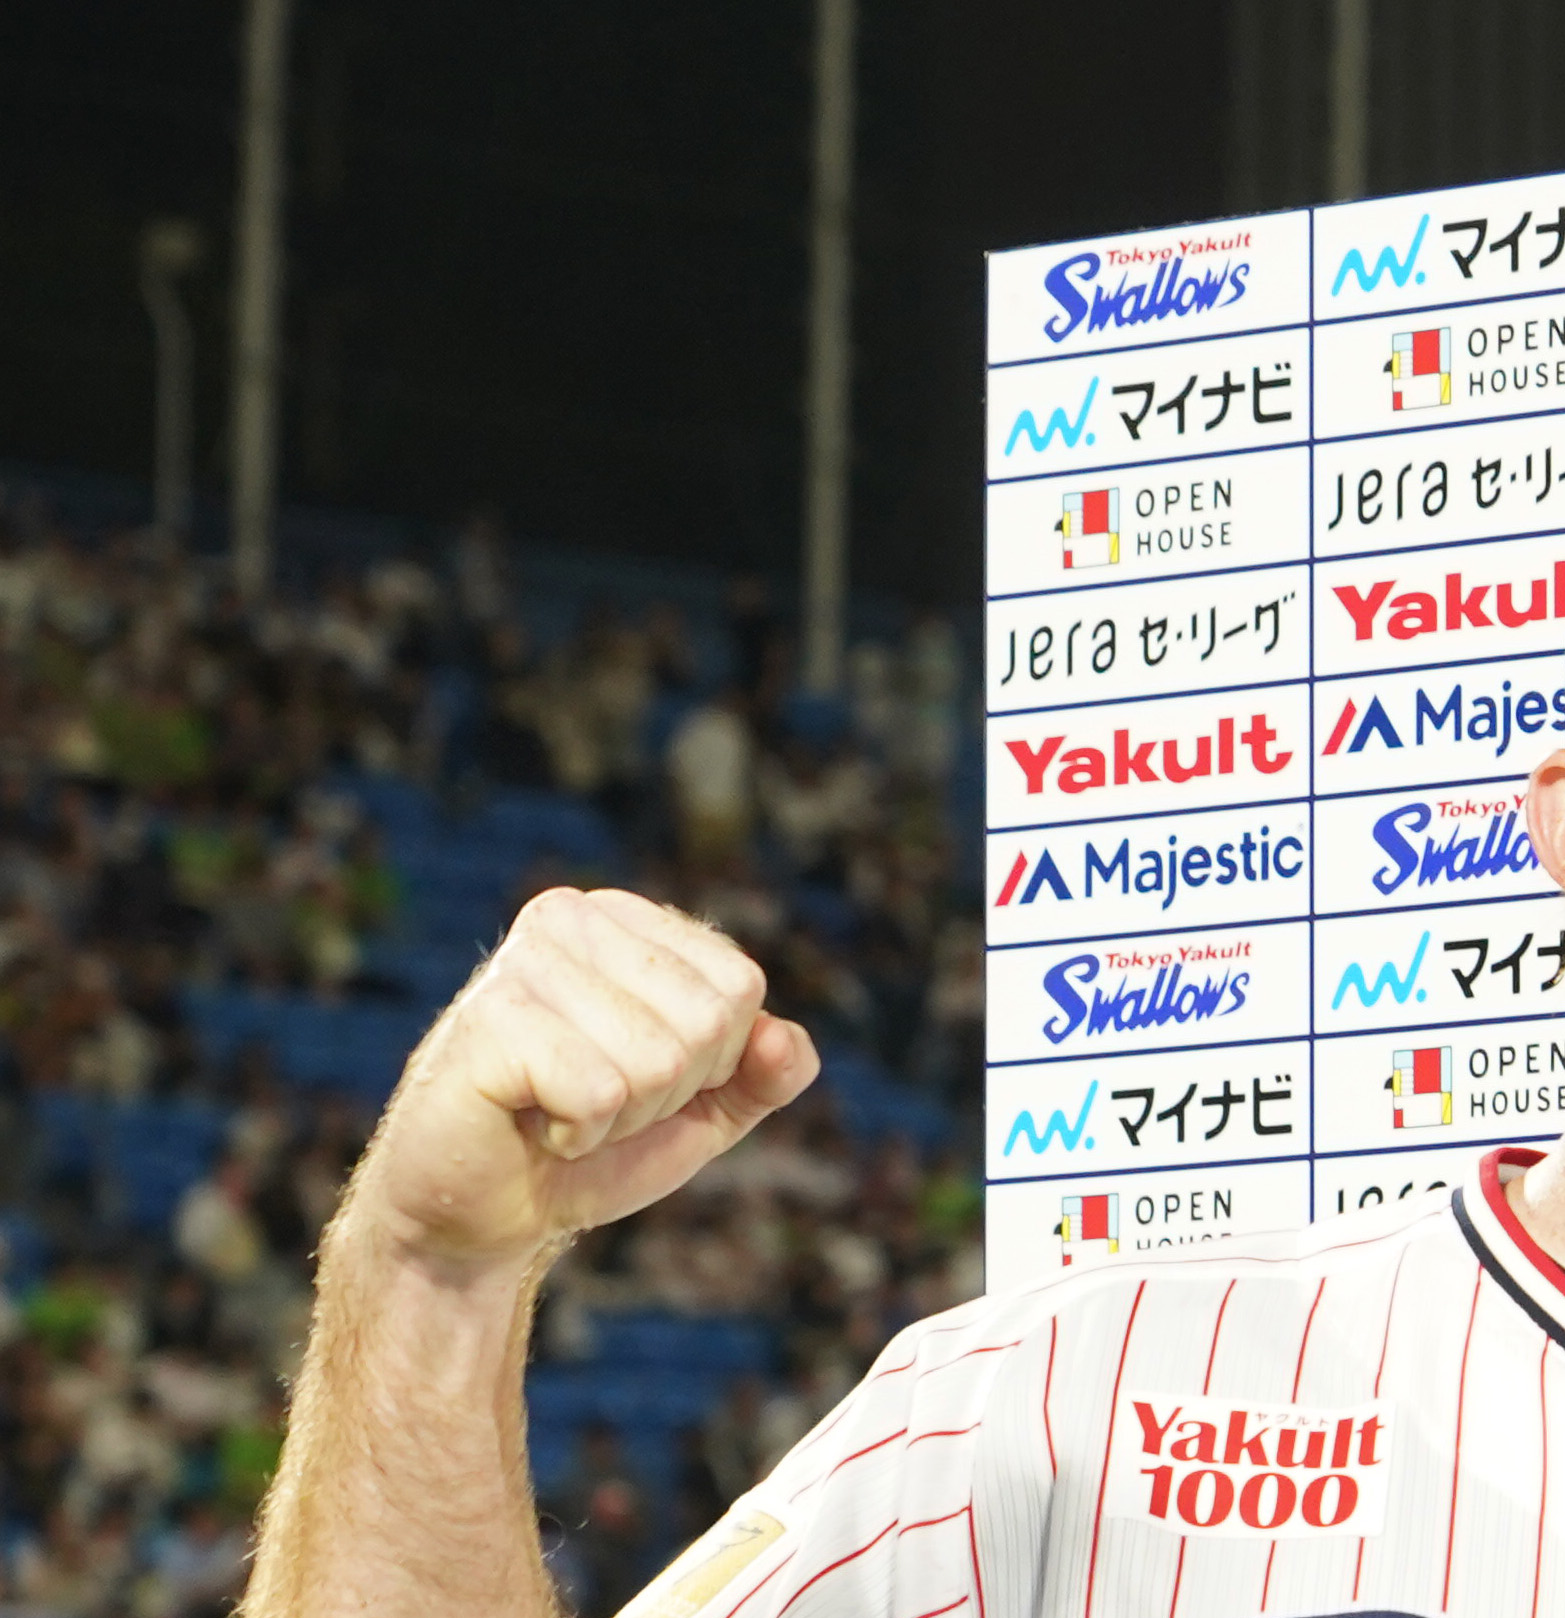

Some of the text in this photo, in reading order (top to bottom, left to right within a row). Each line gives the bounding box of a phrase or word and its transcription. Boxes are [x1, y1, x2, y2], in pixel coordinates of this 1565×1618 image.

[1107, 233, 1252, 265] Tokyo Yakult
[1042, 251, 1251, 344] Swallows
[1112, 362, 1292, 440] マイナビ
[1136, 480, 1231, 518] OPEN
[1137, 522, 1230, 553] HOUSE
[1003, 713, 1295, 795] Yakult
[1437, 799, 1508, 818] Tokyo
[1083, 825, 1304, 911] Majestic
[1105, 942, 1252, 969] Tokyo Yakult
[1041, 953, 1251, 1046] Swallows
[1111, 1074, 1293, 1147] マイナビ
[1135, 1190, 1231, 1225] OPEN
[1130, 1398, 1389, 1471] Yakult
[1139, 1467, 1361, 1532] 1000
